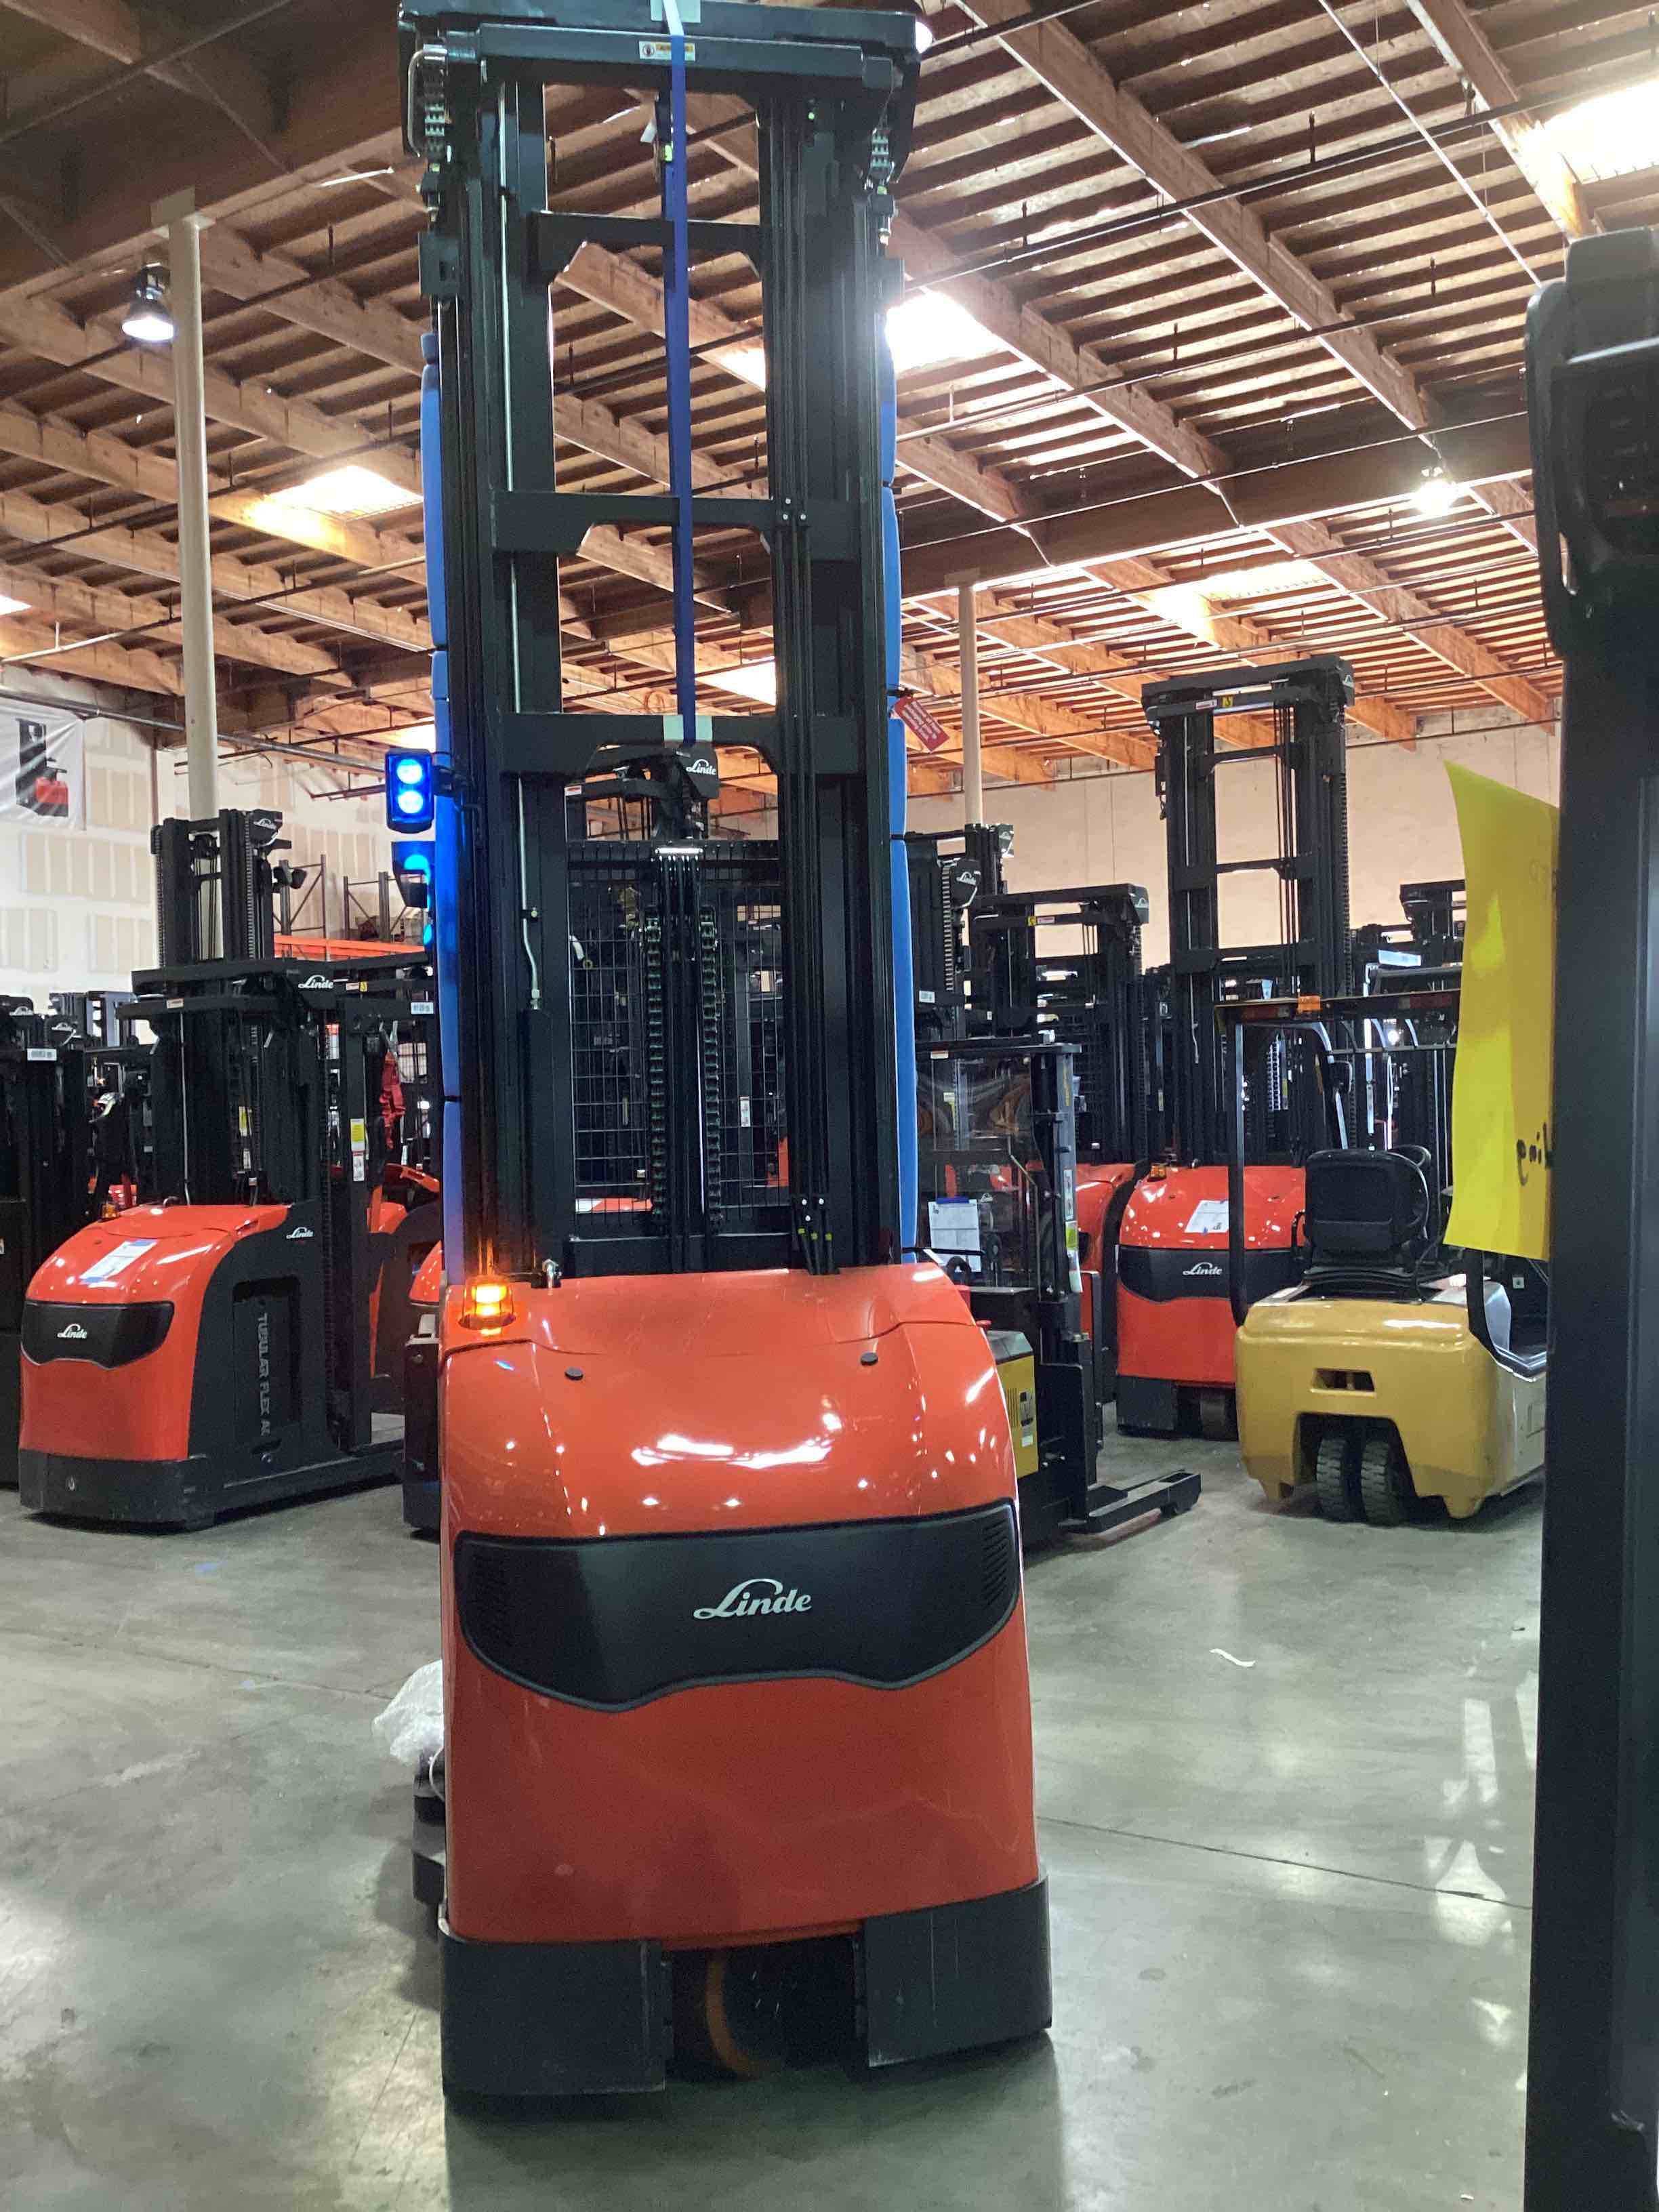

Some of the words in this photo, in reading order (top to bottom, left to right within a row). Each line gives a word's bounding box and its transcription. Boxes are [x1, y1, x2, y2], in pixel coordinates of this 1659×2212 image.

[686, 759, 716, 775] Linde
[298, 975, 334, 989] Linde
[1182, 1262, 1223, 1275] Linde
[57, 1324, 87, 1339] Linde
[693, 1578, 813, 1620] Linde
